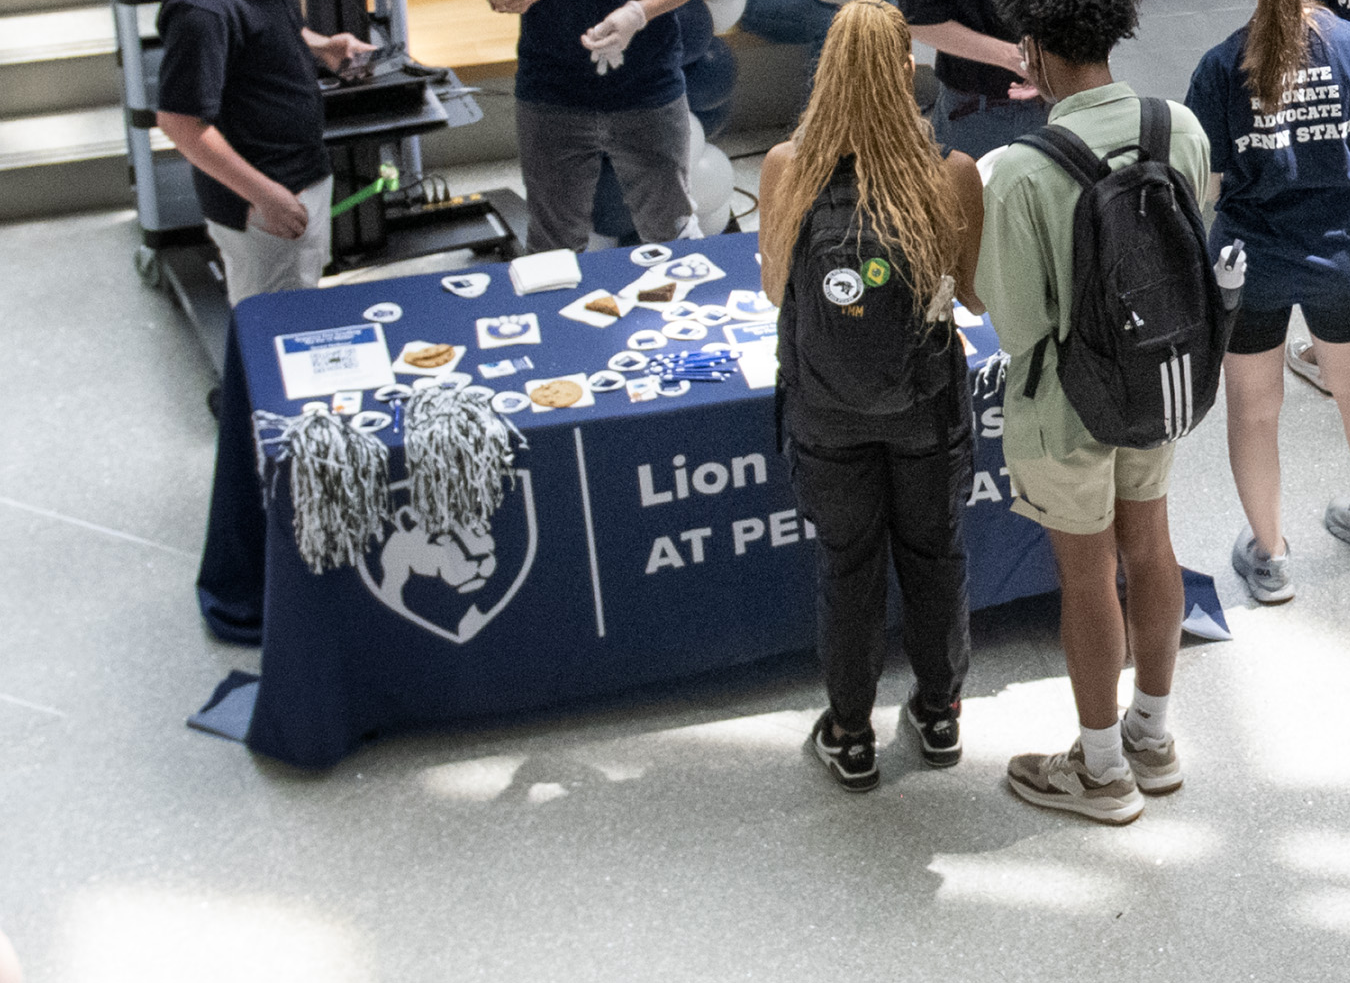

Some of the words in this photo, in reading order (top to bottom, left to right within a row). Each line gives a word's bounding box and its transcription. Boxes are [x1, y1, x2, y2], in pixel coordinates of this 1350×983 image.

[1250, 84, 1341, 111] RONATE
[1253, 103, 1343, 129] ADVOCATE
[1234, 129, 1292, 154] PENN
[637, 452, 767, 507] Lion
[645, 528, 713, 574] AT
